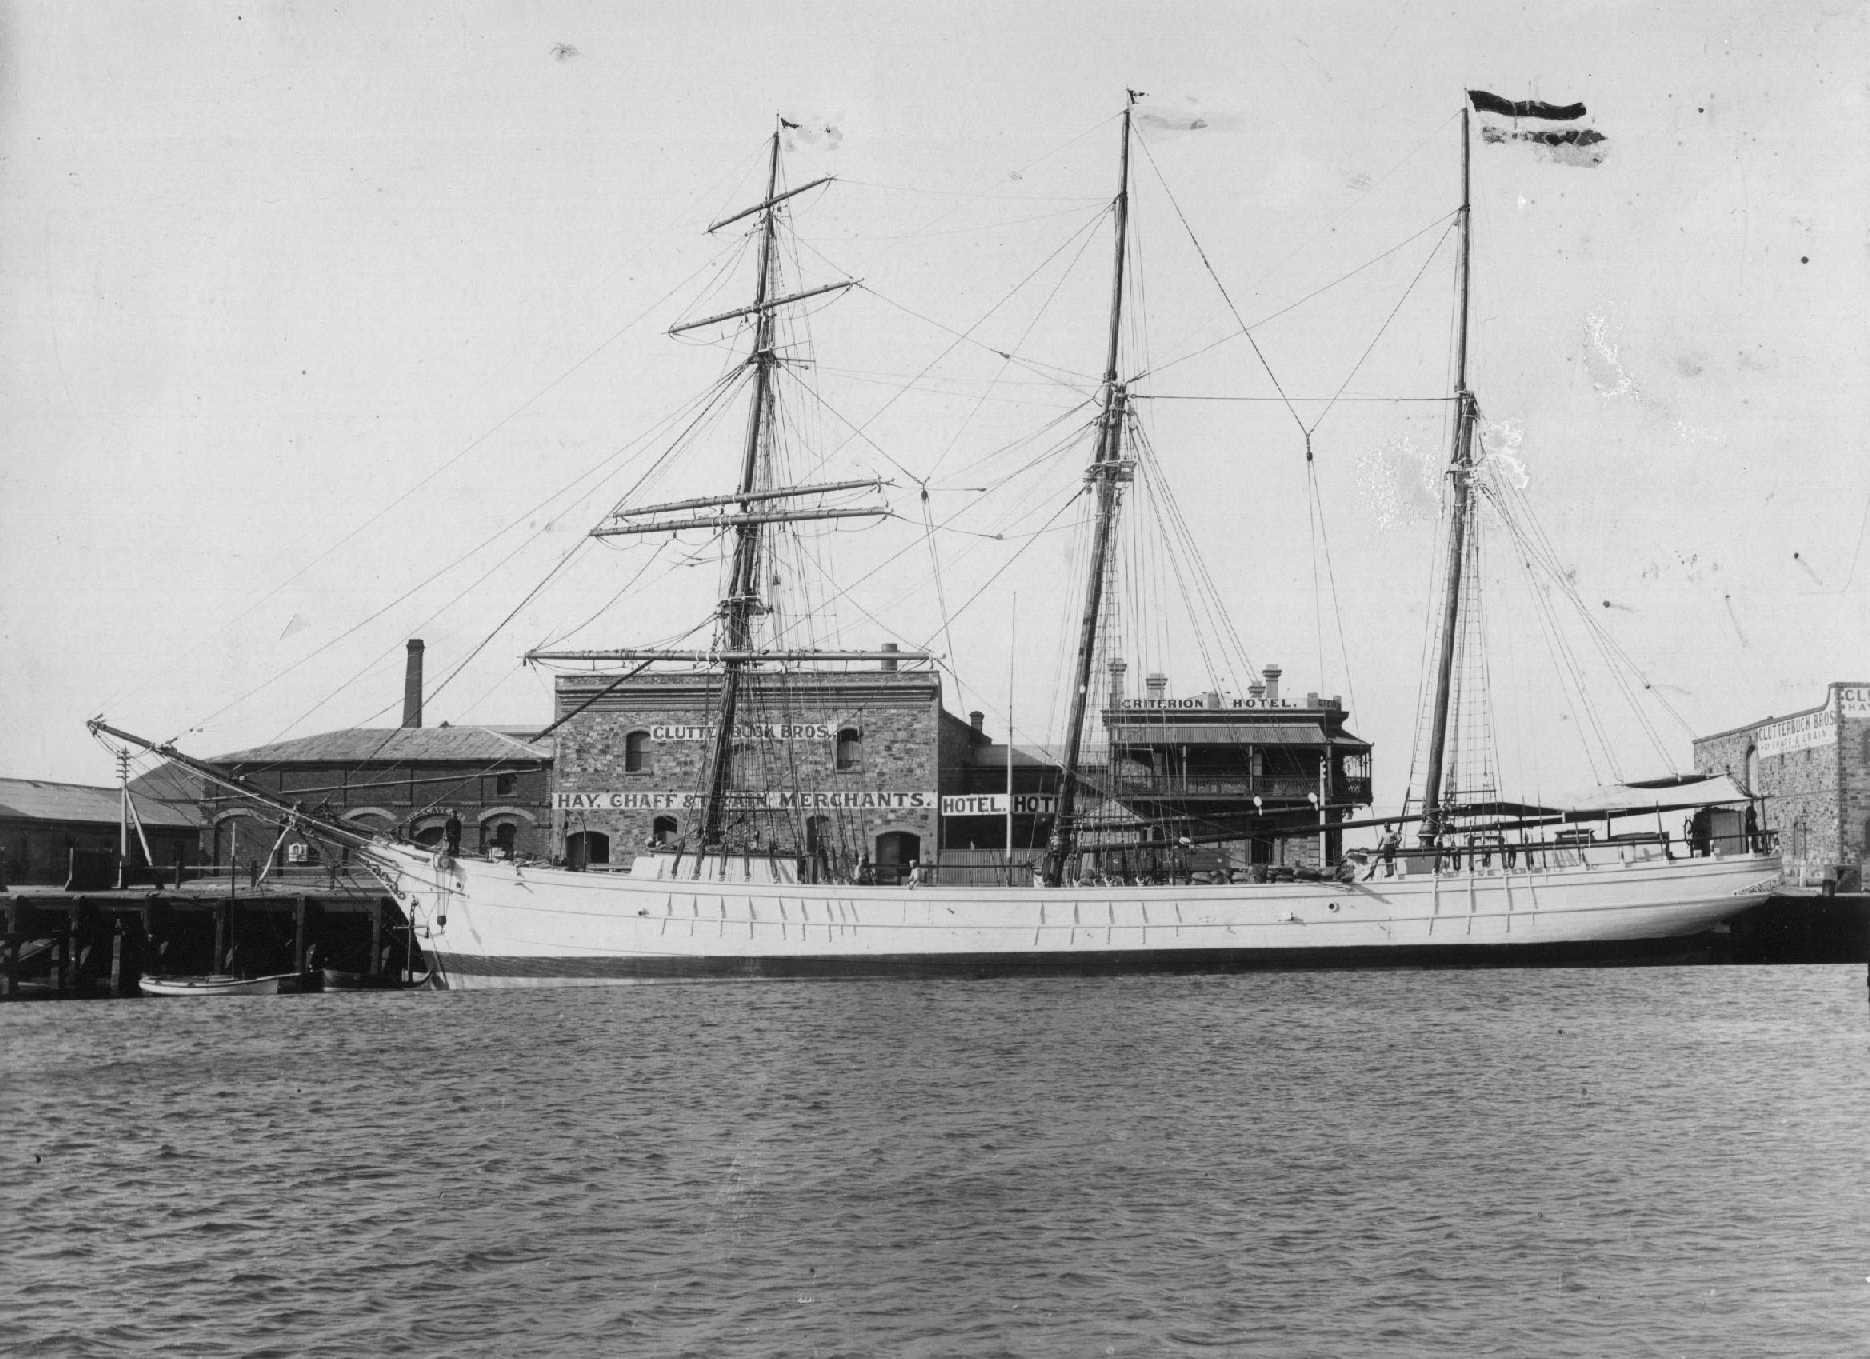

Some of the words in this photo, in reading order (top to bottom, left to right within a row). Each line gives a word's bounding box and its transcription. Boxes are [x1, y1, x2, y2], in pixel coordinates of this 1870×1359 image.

[1121, 699, 1204, 709] CRITERION
[653, 725, 776, 739] CLUTTEBUCK
[611, 793, 678, 808] CHAFF
[682, 794, 695, 808] &
[943, 796, 1008, 814] HOTEL.
